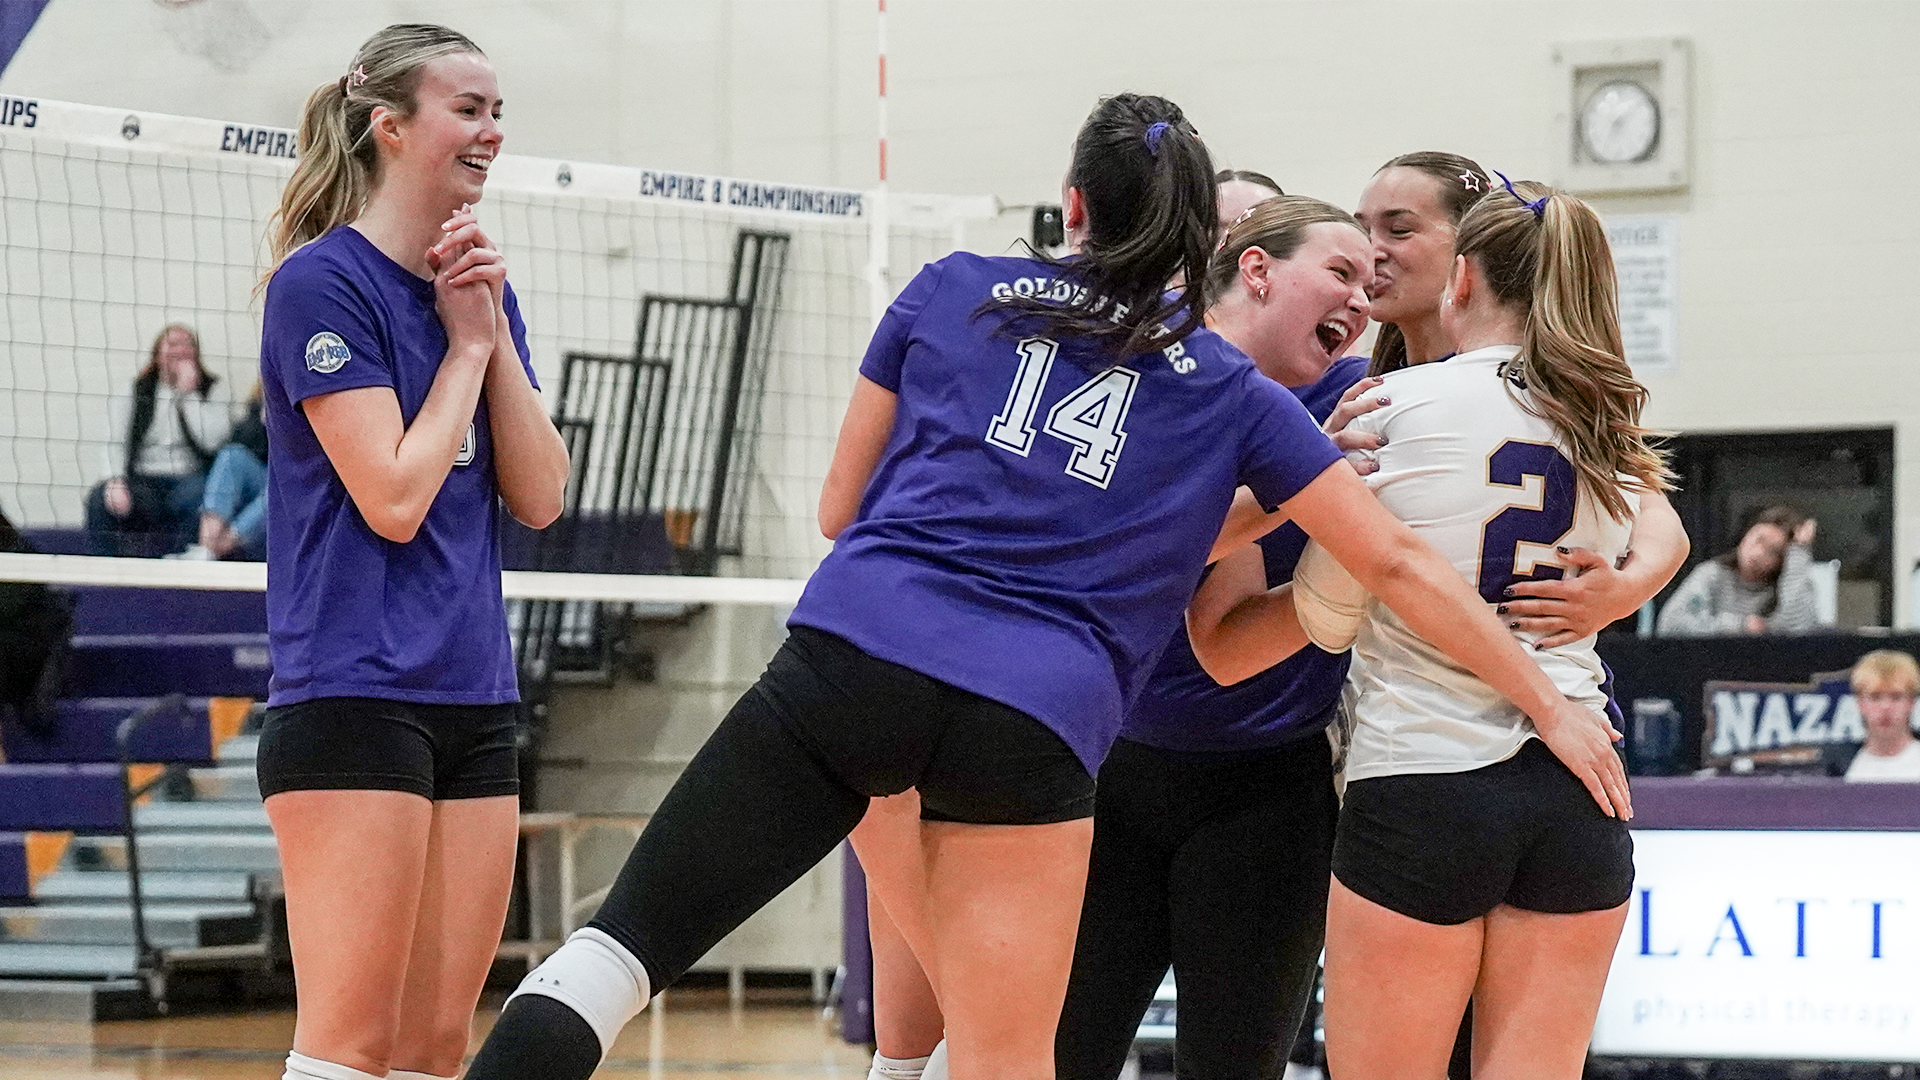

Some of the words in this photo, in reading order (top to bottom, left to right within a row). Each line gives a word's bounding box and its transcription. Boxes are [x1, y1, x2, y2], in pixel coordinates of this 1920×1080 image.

[640, 171, 706, 202] EMPIRE
[712, 179, 722, 203] 8
[728, 182, 862, 217] CHAMPIONSHIPS
[984, 337, 1141, 490] 14
[1475, 437, 1578, 605] 2
[1710, 690, 1920, 756] NAZA
[1632, 992, 1769, 1027] physical
[1784, 994, 1916, 1031] therapy
